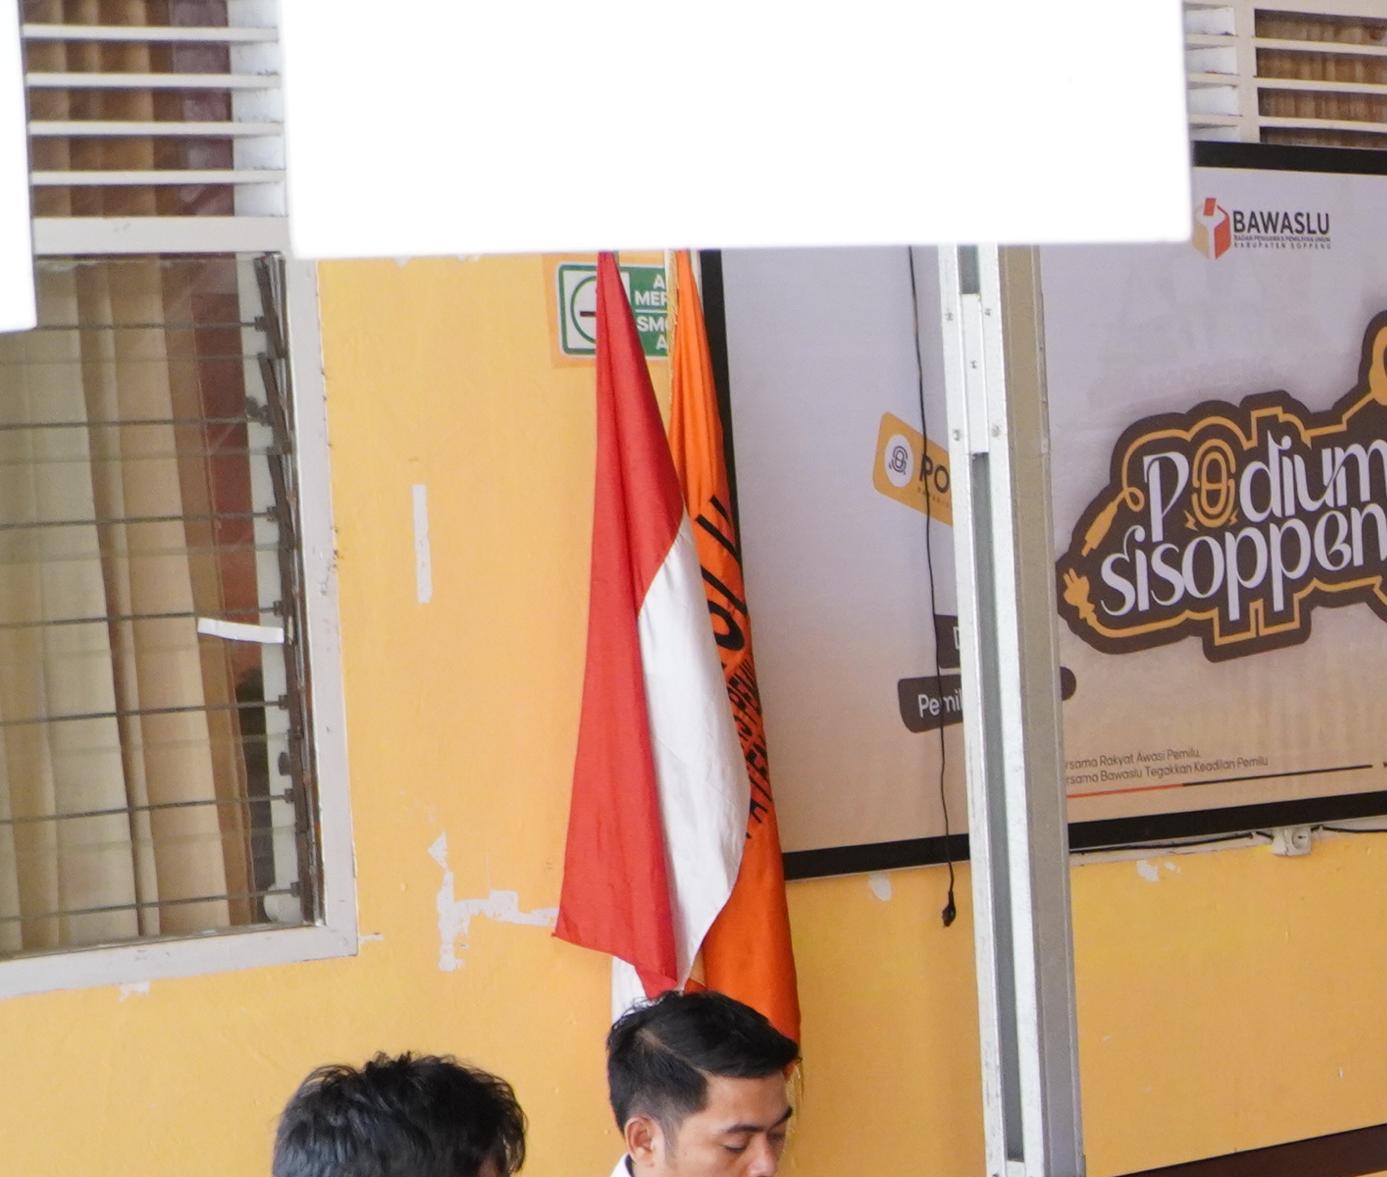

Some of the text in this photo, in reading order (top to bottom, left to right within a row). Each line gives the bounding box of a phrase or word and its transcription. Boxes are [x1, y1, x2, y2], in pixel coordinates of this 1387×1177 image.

[1233, 211, 1329, 235] BAWASLU
[1100, 753, 1134, 770] Rakyat
[1136, 752, 1165, 763] Awasi
[1101, 768, 1143, 783] Bawaslu
[1145, 764, 1192, 780] Tegakkan
[1194, 760, 1236, 774] Keadilan
[1237, 755, 1268, 768] Pemilu
